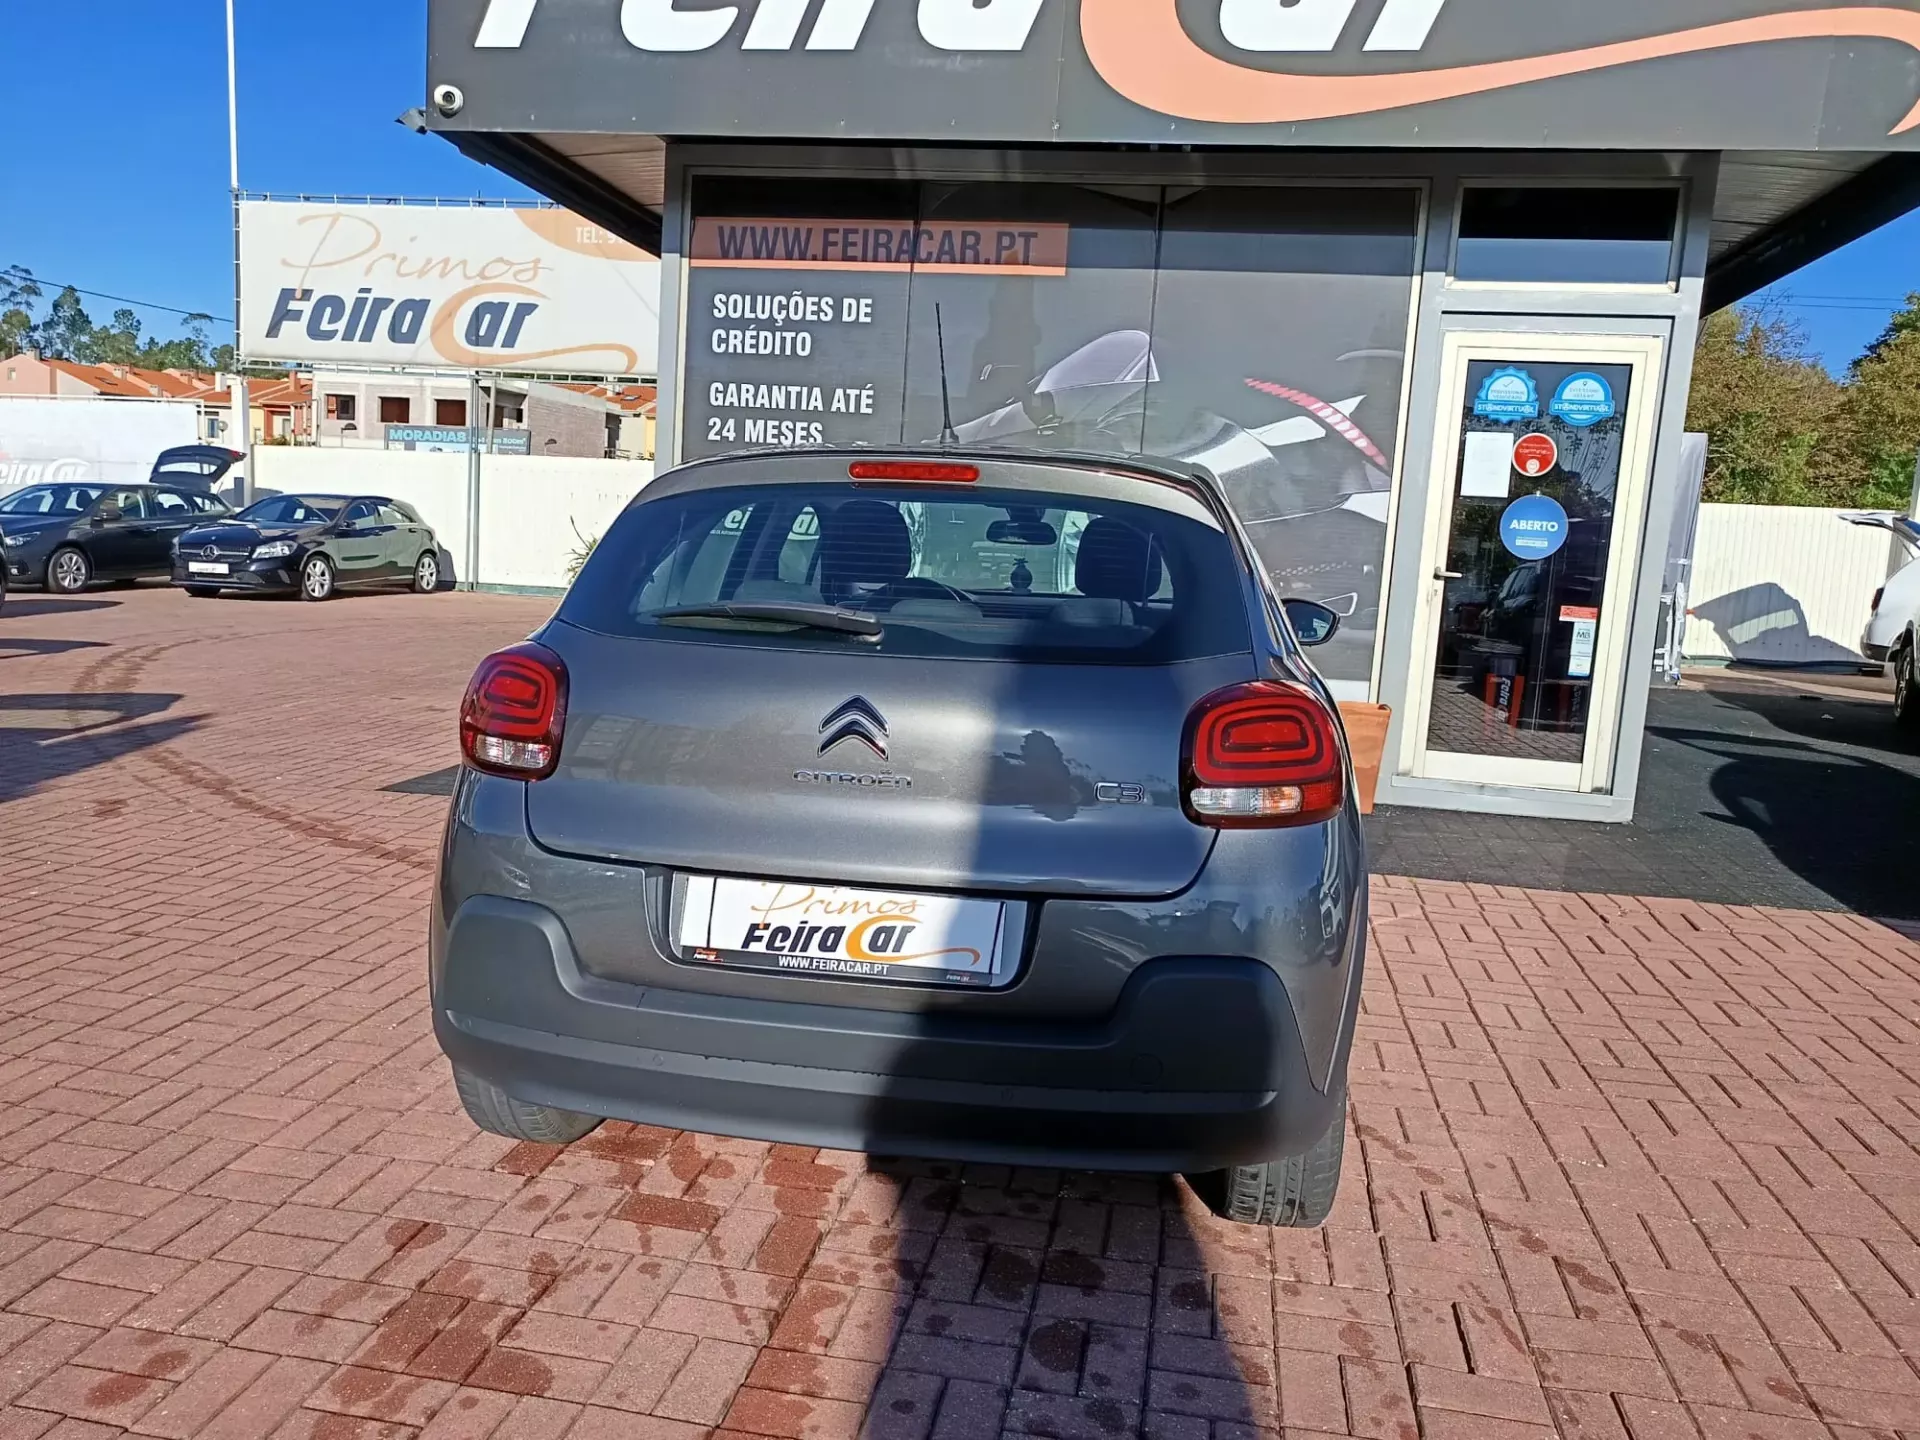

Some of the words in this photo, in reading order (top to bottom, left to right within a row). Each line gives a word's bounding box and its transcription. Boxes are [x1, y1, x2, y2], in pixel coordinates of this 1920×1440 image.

[280, 212, 554, 299] Primos
[717, 225, 1039, 265] WWW.FEIRACAR.PT
[712, 290, 834, 326] SOLUÇÕES
[841, 298, 873, 323] DE
[711, 324, 812, 357] CRÉDITO
[709, 382, 824, 411] GARANTIA
[830, 383, 874, 414] ATÉ
[707, 417, 736, 442] 24
[744, 418, 823, 446] MESES
[1509, 519, 1559, 533] ABERTO
[793, 768, 913, 789] CITROËN
[1093, 781, 1145, 804] C3
[778, 955, 890, 977] WWW.FEIRACAR.PT
